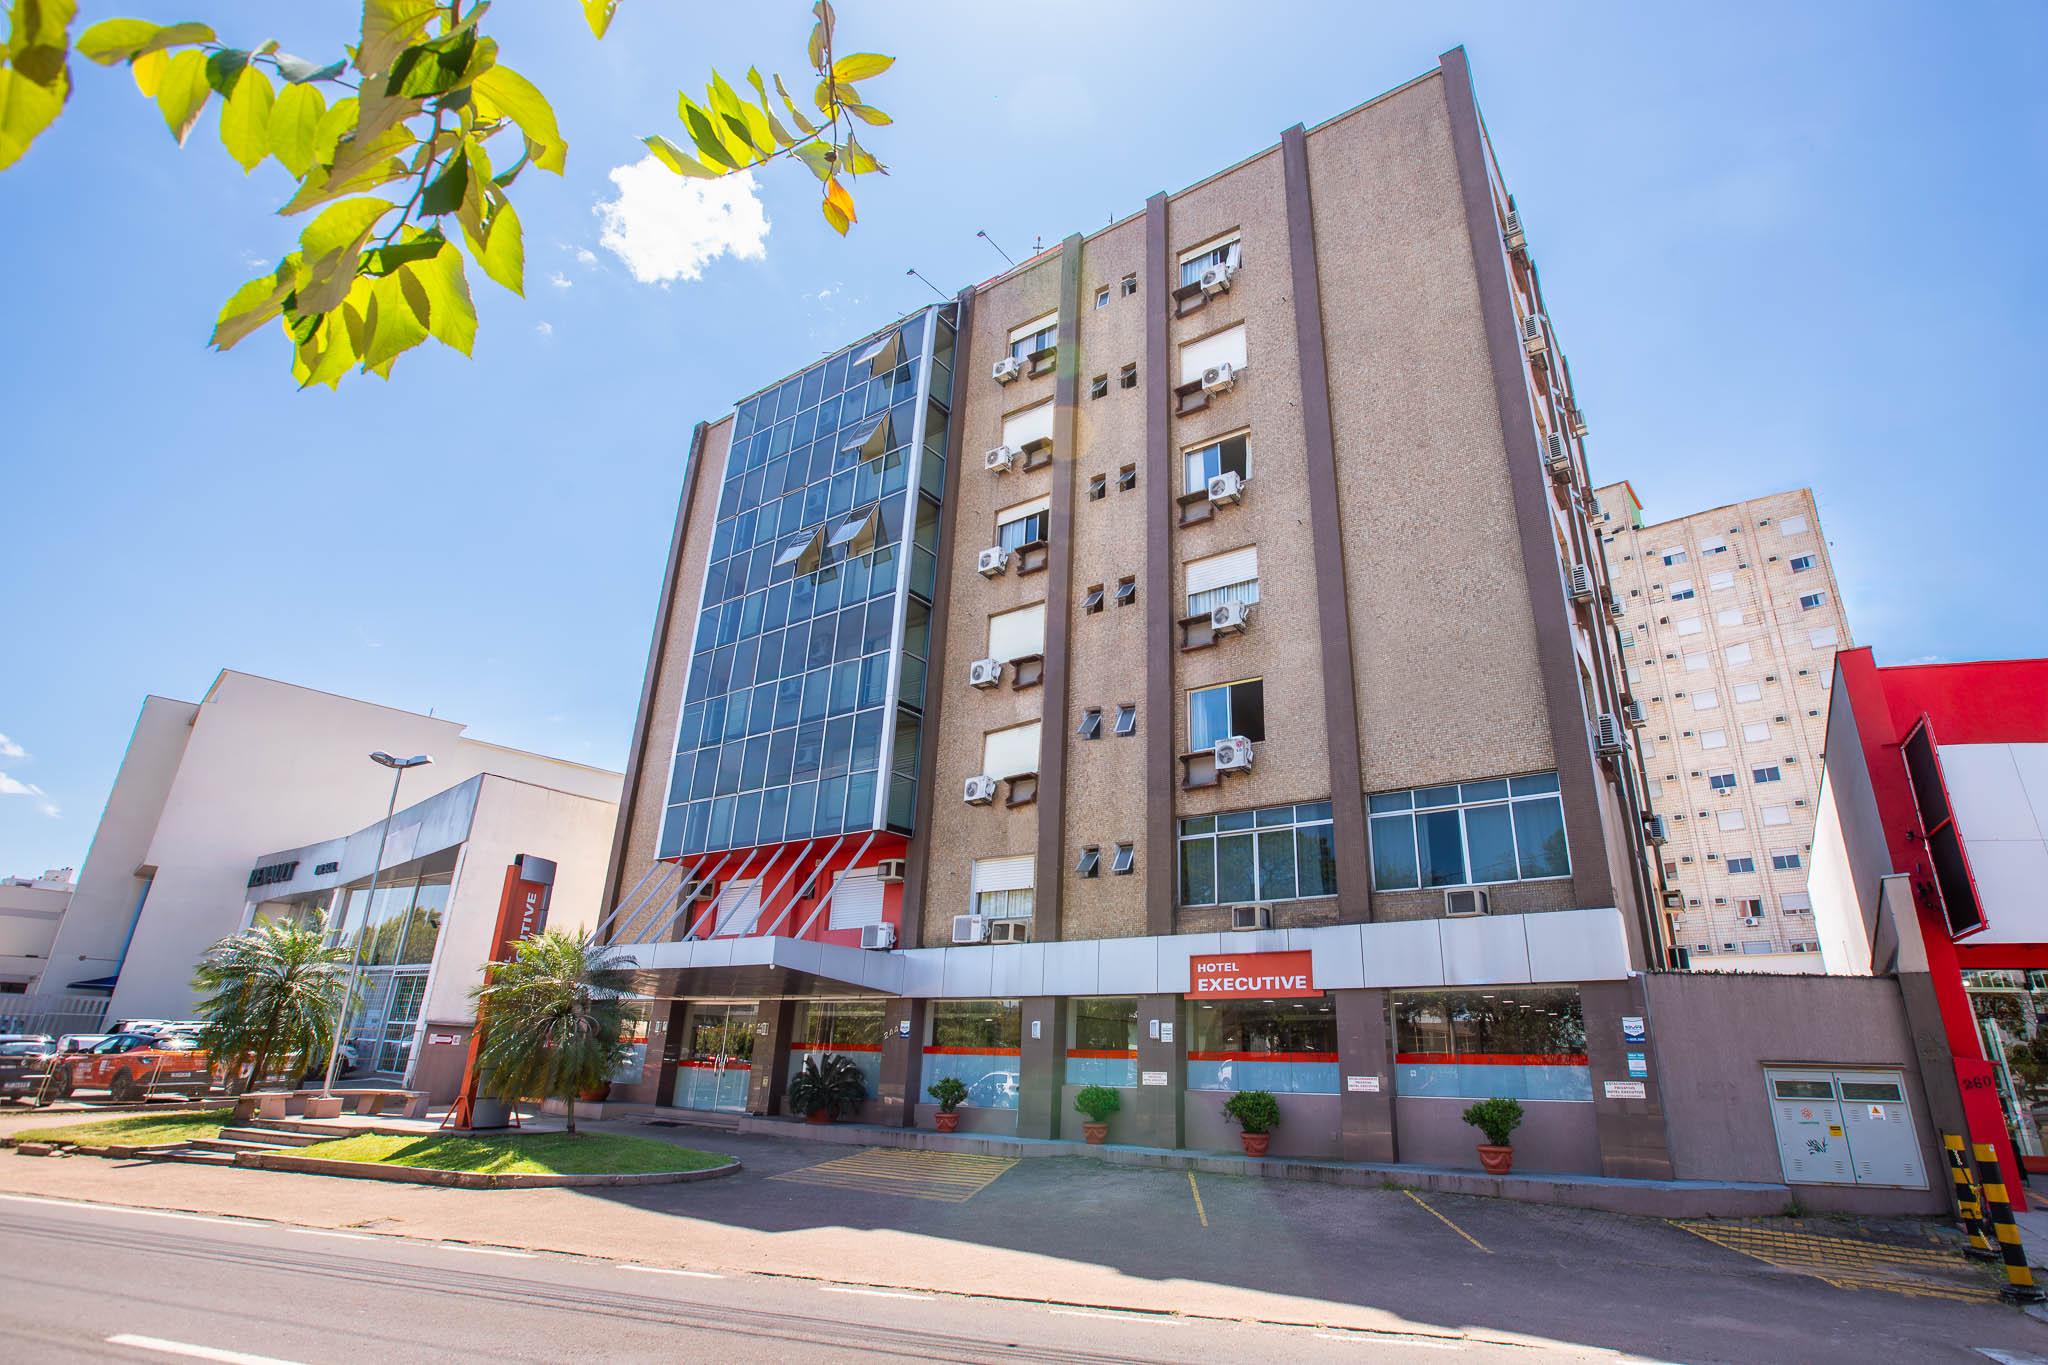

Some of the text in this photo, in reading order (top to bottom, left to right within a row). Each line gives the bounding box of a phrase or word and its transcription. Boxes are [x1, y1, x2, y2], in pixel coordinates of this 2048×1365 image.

[1197, 962, 1240, 973] HOTEL
[1198, 975, 1307, 992] EXECUTIVE
[1962, 1076, 1992, 1091] 260
